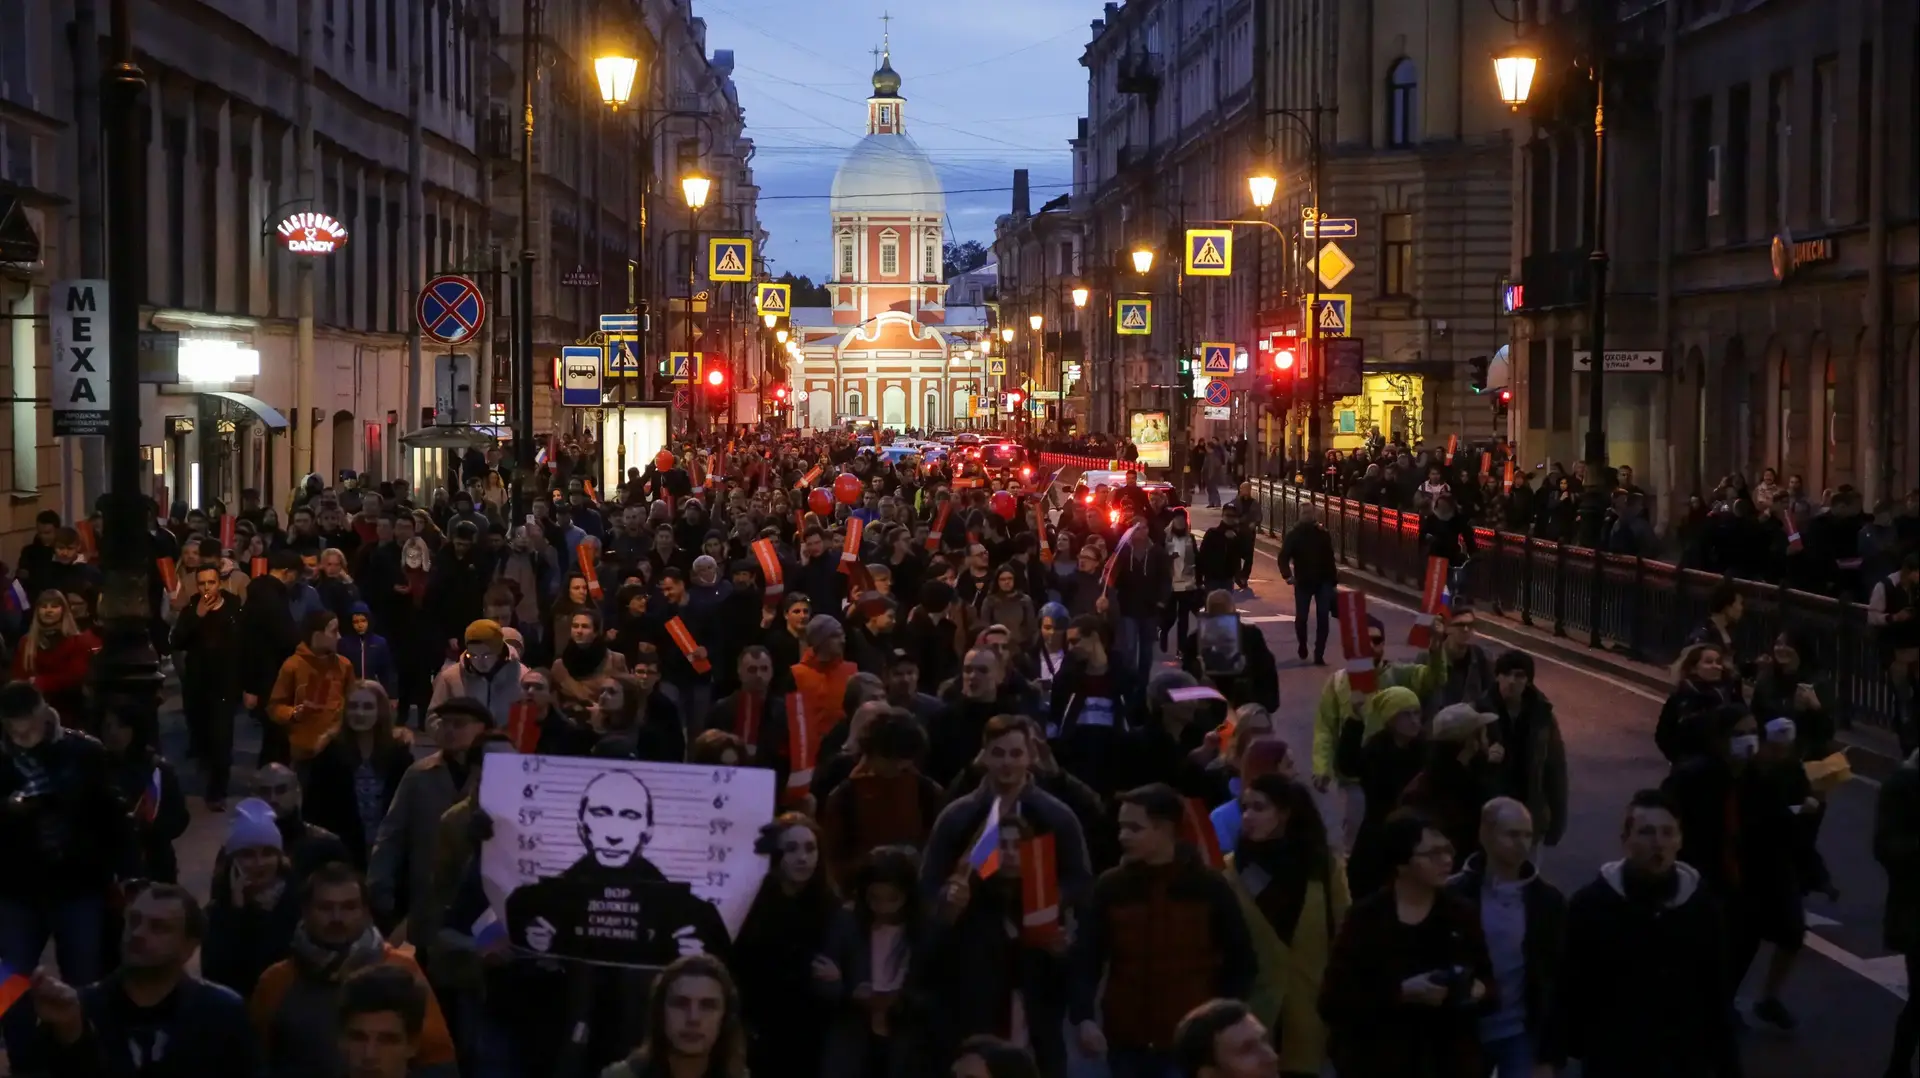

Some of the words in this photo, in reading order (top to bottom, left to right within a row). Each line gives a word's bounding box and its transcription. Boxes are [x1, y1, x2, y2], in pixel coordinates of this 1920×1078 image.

[277, 212, 346, 238] ГАСТРОБАР
[288, 239, 335, 252] DANDY
[67, 286, 96, 403] МЕХА
[1603, 353, 1639, 361] ОХОВАЯ
[604, 887, 632, 899] ВОР
[587, 899, 640, 913] ДОЛЖЕН
[588, 926, 638, 941] КРЕМЛЕ
